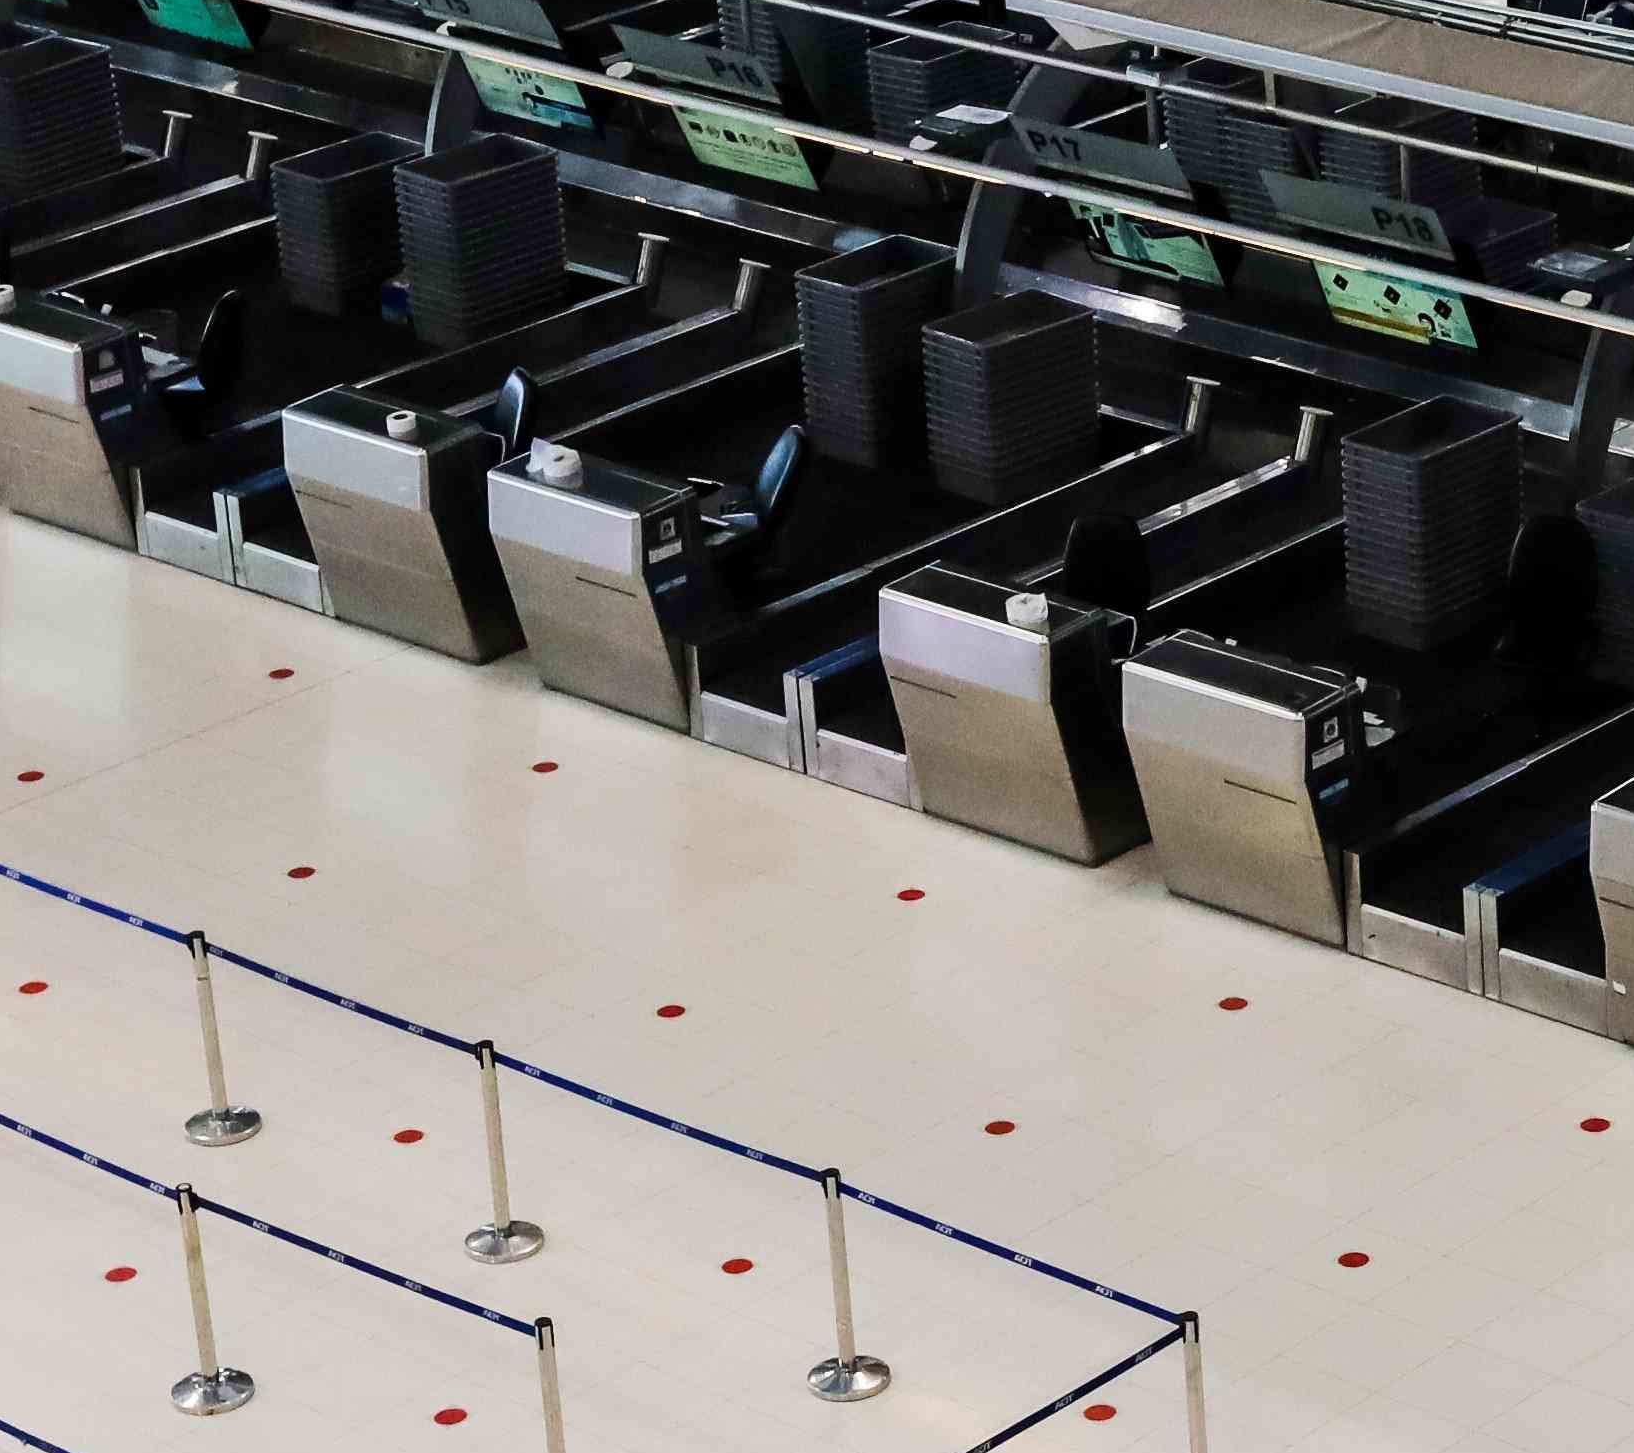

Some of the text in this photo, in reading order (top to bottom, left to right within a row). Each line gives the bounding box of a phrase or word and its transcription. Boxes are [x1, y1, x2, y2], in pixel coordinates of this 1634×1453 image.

[708, 57, 762, 88] P16
[1026, 128, 1083, 162] P17
[1372, 206, 1433, 244] P18
